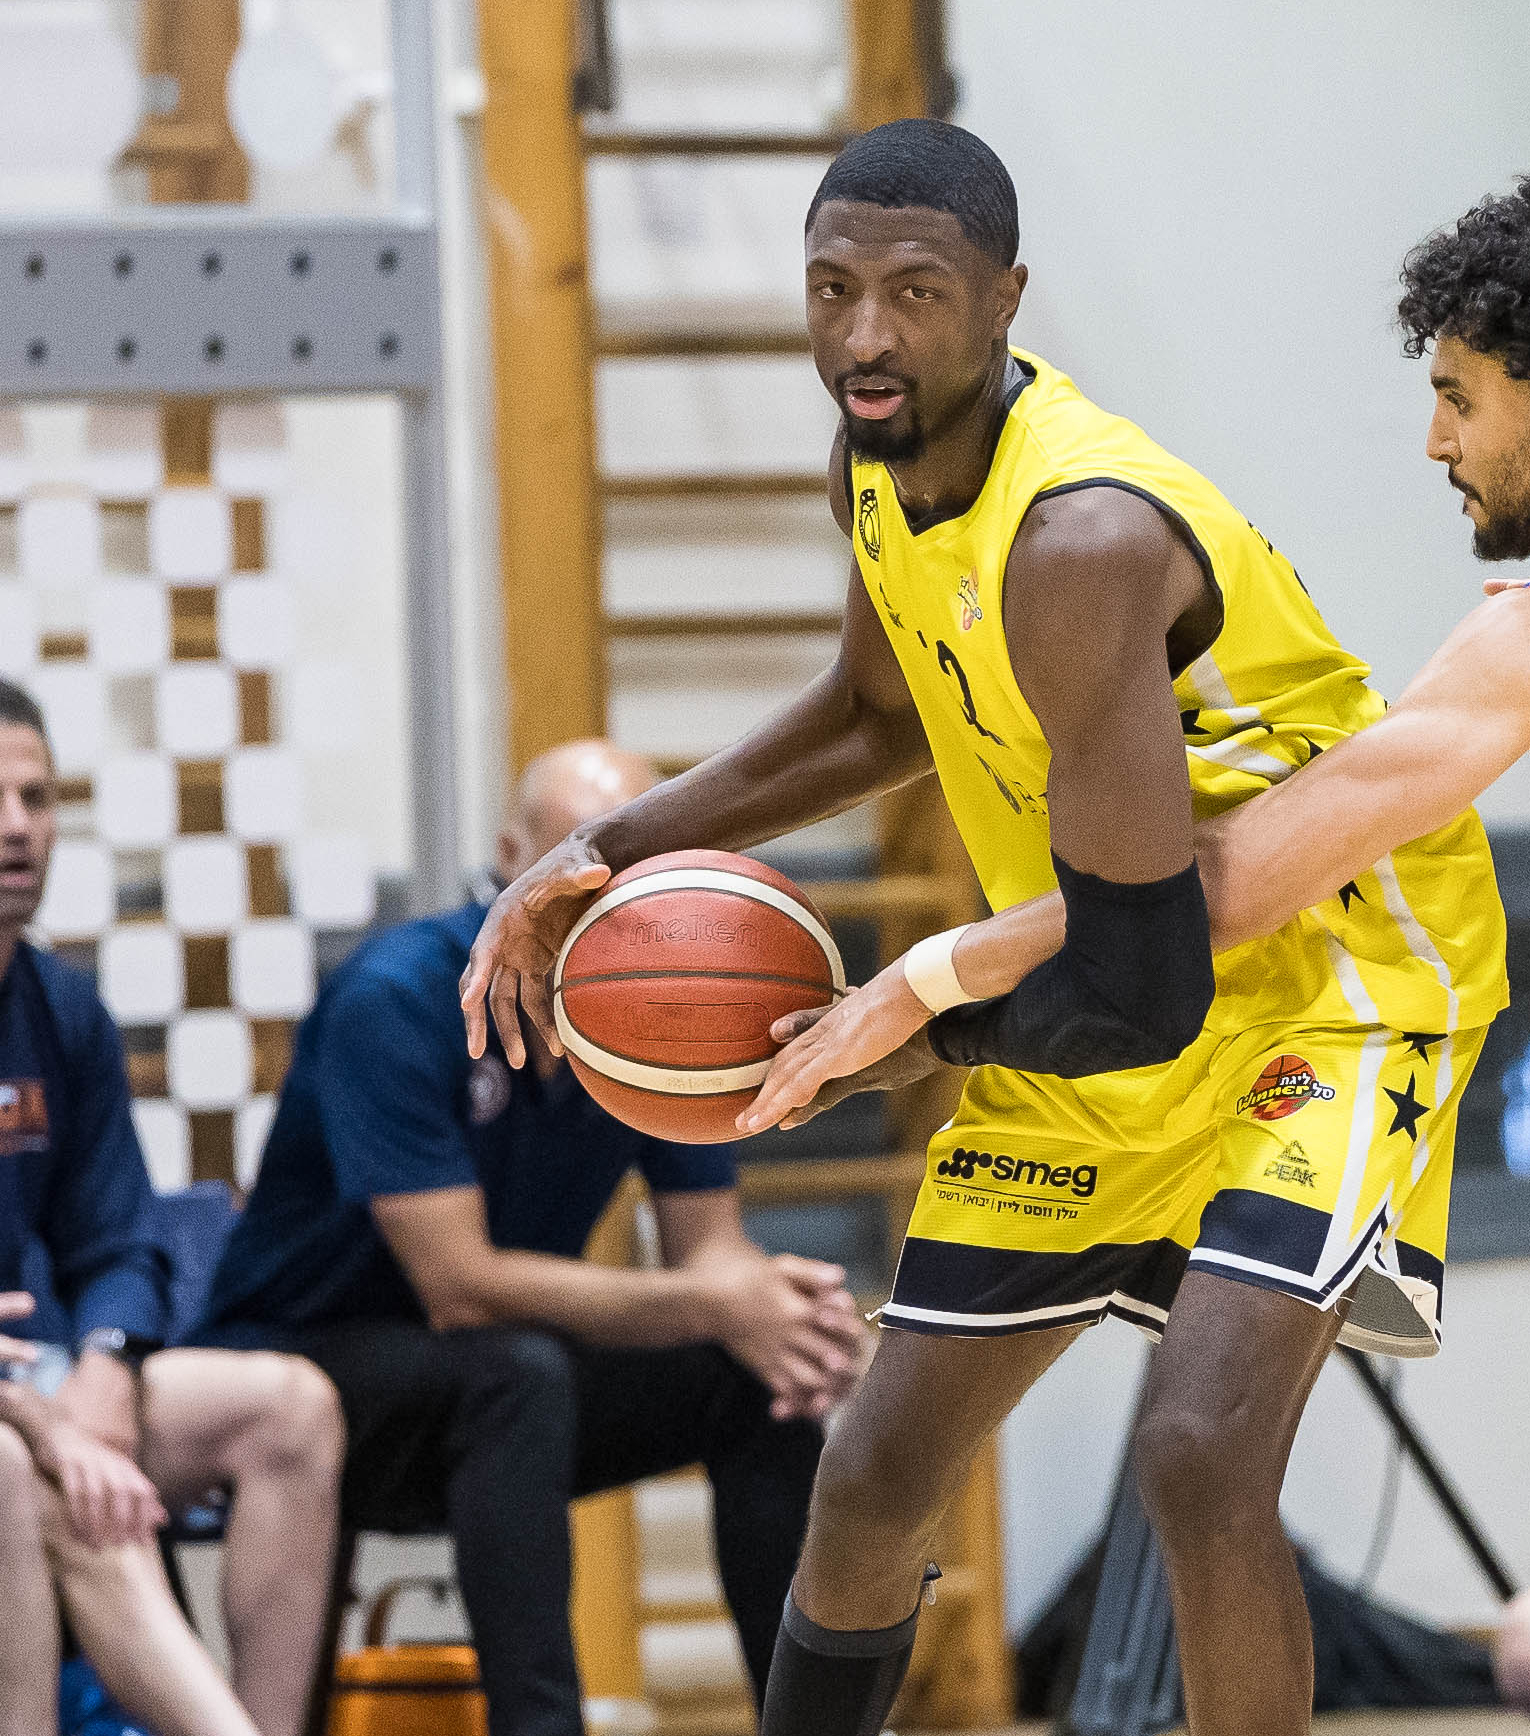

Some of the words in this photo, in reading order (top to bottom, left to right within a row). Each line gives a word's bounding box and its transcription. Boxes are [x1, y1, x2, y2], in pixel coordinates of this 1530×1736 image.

[628, 914, 758, 946] molten
[1280, 1072, 1311, 1086] ליגת
[1312, 1082, 1335, 1100] סל
[991, 1155, 1098, 1197] smeg
[1263, 1161, 1319, 1188] PEAK
[936, 1188, 960, 1203] רשמי
[963, 1195, 990, 1206] יבואן
